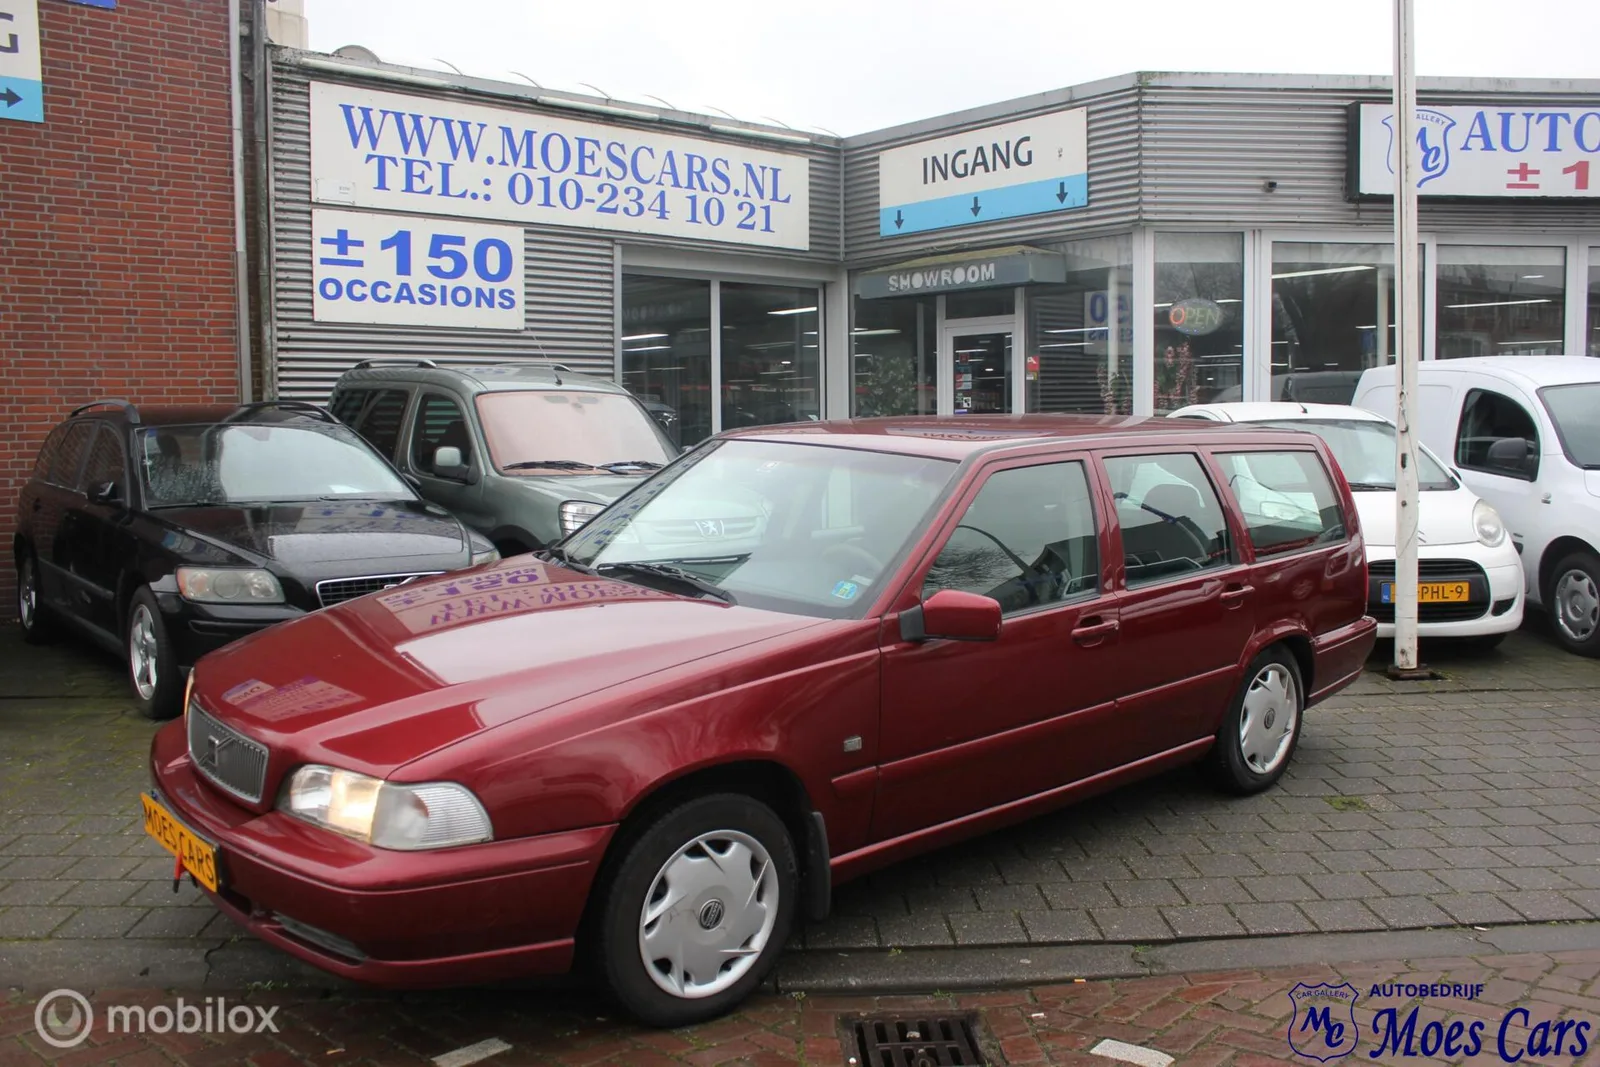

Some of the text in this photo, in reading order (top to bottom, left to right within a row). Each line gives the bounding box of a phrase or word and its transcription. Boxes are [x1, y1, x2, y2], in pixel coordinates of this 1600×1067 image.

[1415, 113, 1446, 126] ALLERY
[338, 103, 792, 204] WWW.MOESCARS.NL
[922, 135, 1033, 185] INGANG
[365, 153, 776, 233] TEL.: 010-234 10 21
[380, 229, 514, 284] 150
[888, 262, 996, 292] SHOWROOM
[318, 277, 516, 310] OCCASIONS
[1170, 306, 1220, 327] OPEN
[1417, 585, 1464, 600] -PHL-9
[142, 800, 214, 882] MOES CARS
